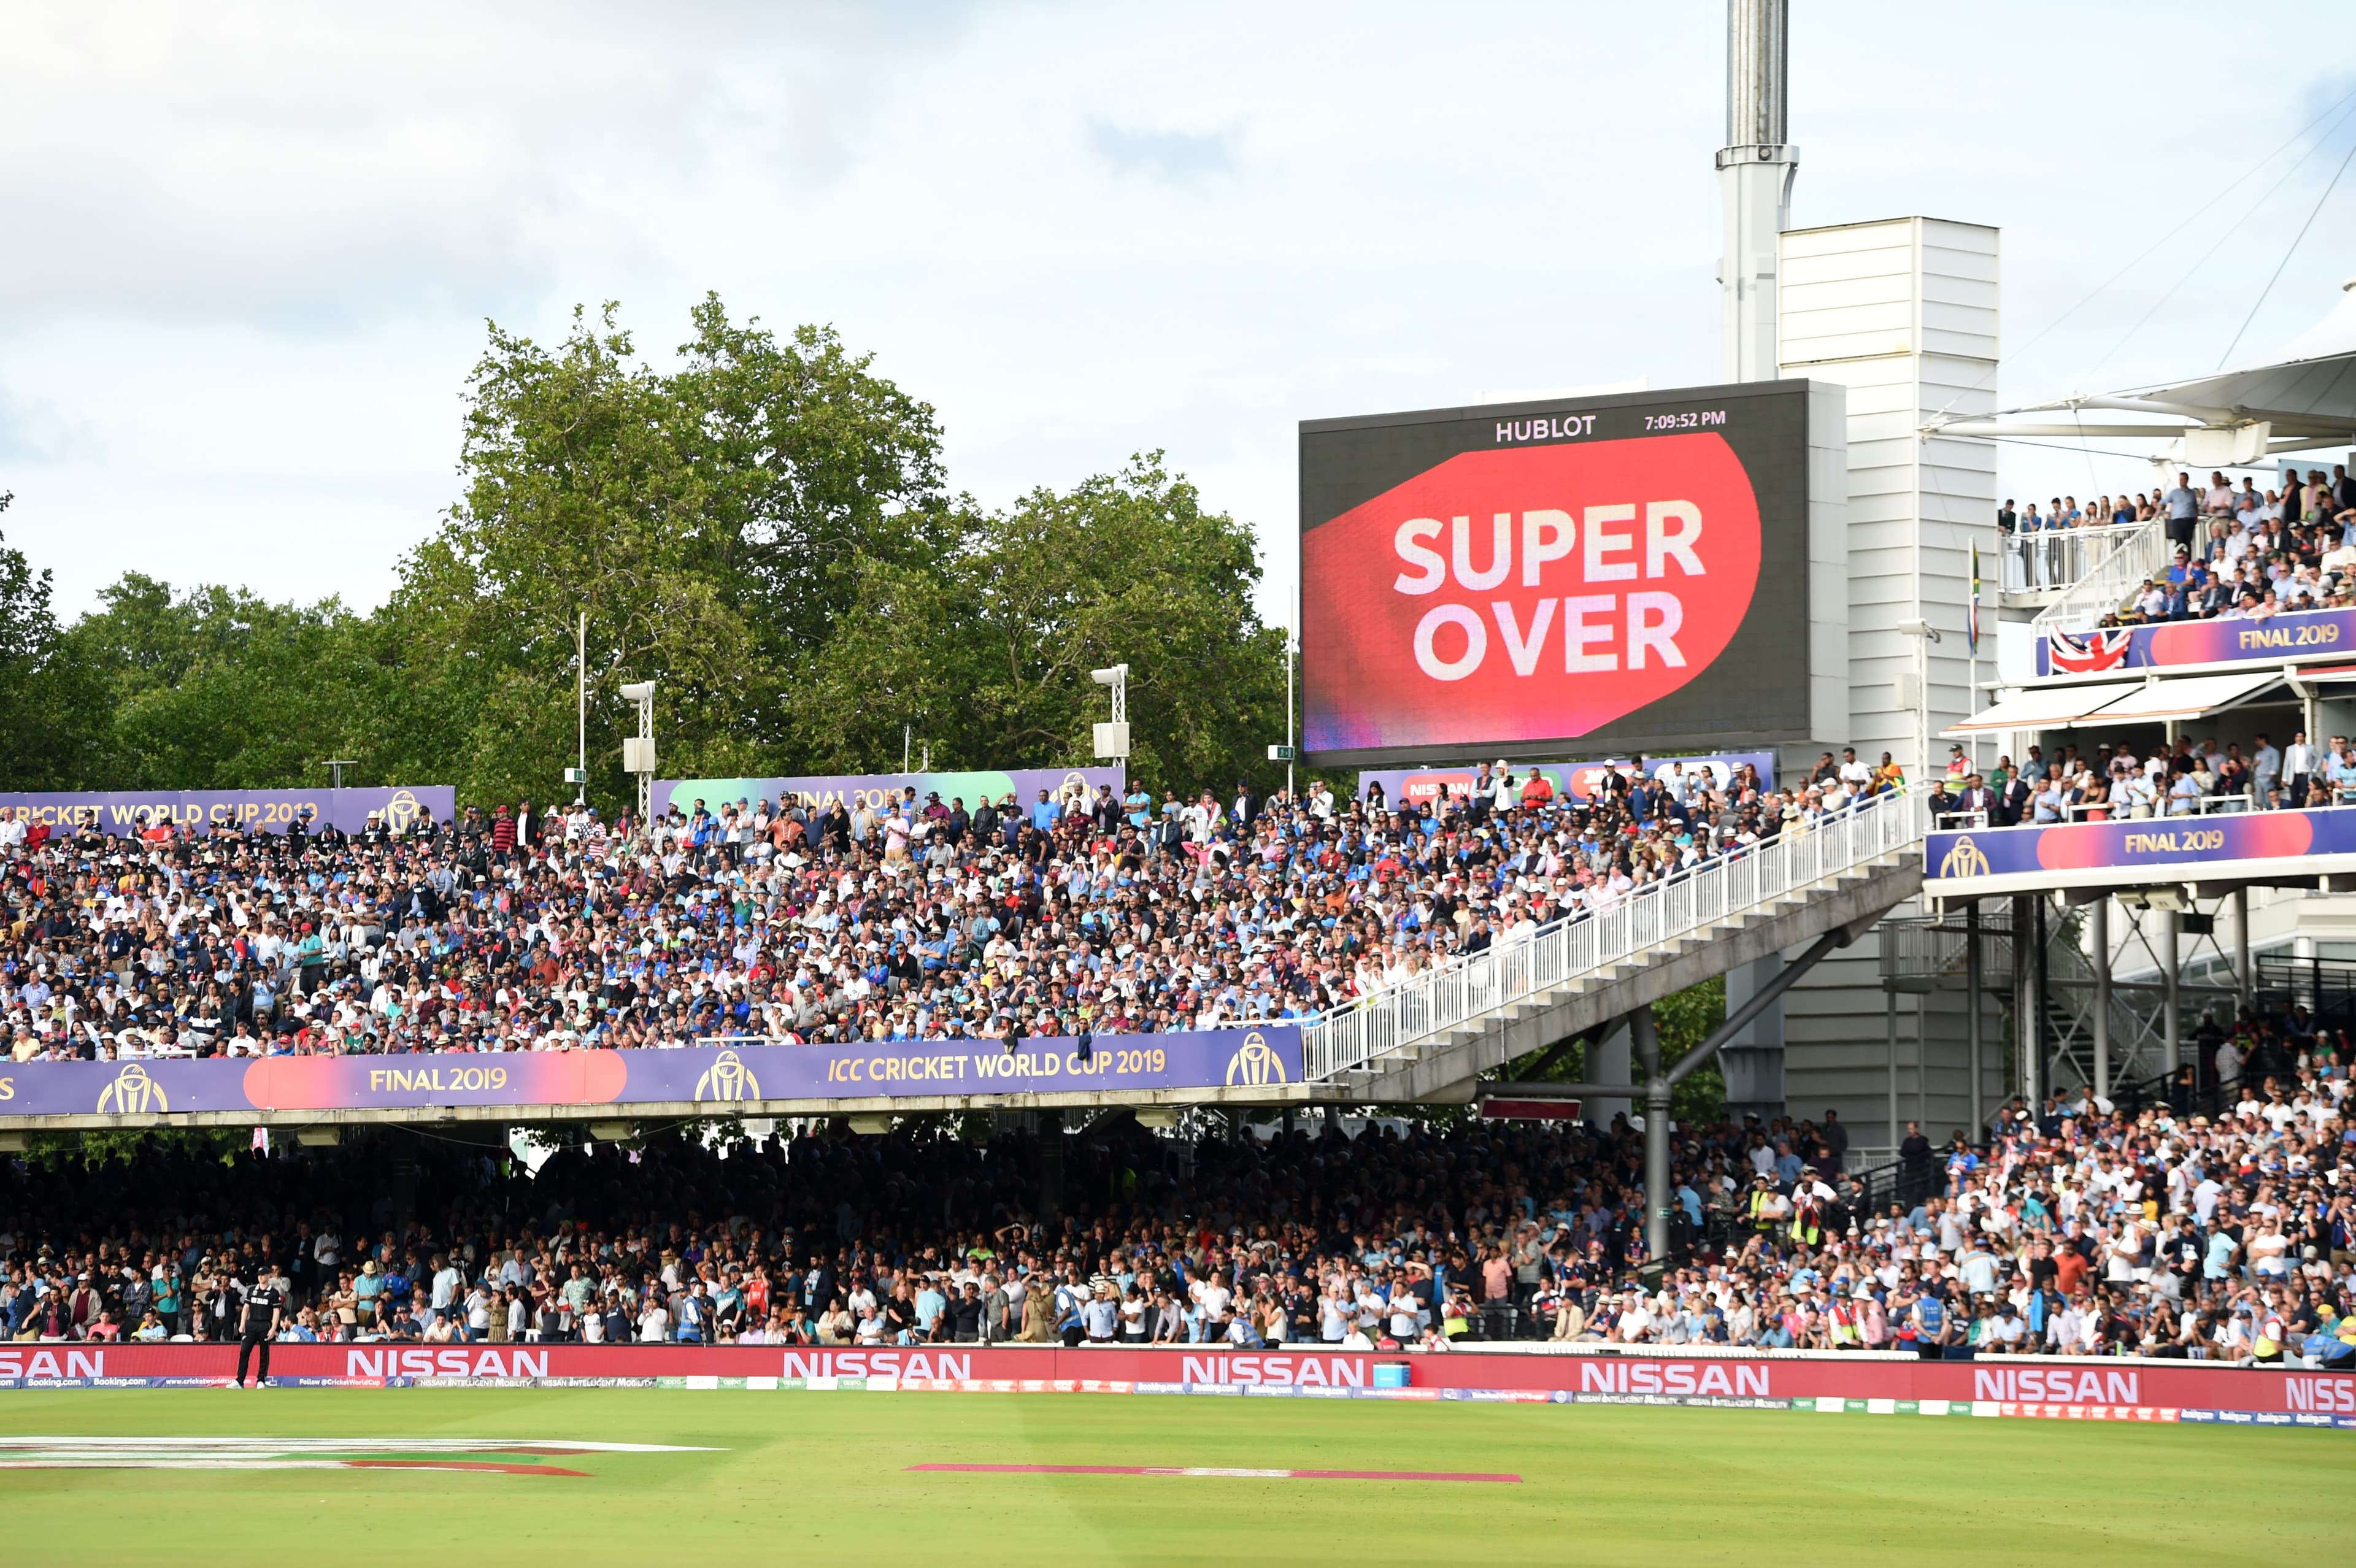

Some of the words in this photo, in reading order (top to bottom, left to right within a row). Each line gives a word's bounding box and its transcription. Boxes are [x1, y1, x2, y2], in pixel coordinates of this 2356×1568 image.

[1496, 416, 1595, 442] HUBLOT
[1645, 413, 1699, 431] 7:09:52
[1703, 410, 1726, 426] PM
[1393, 499, 1706, 595] SUPER
[1413, 591, 1687, 681] OVER
[2239, 628, 2293, 649] FINAL
[2295, 623, 2339, 644] 2019
[789, 790, 850, 810] INAL
[1410, 783, 1469, 796] NISAN
[110, 804, 203, 826] WORLD
[2125, 832, 2180, 853] FINAL
[2182, 829, 2224, 851] 2019
[828, 1058, 864, 1082] ICC
[869, 1056, 968, 1081] CRICKET
[974, 1052, 1060, 1078] WORLD
[1066, 1050, 1112, 1075] CUP
[1116, 1048, 1165, 1074] 2019
[369, 1069, 446, 1092] FINAL
[448, 1067, 507, 1090] 2019
[347, 1350, 549, 1377] NISSAN
[783, 1352, 971, 1380] NISSAN
[1182, 1356, 1364, 1387] NISSAN
[28, 1378, 81, 1388] Booking.com
[94, 1377, 147, 1386] Booking.com
[1581, 1362, 1769, 1396] NISSAN
[1974, 1369, 2139, 1404] NISSAN
